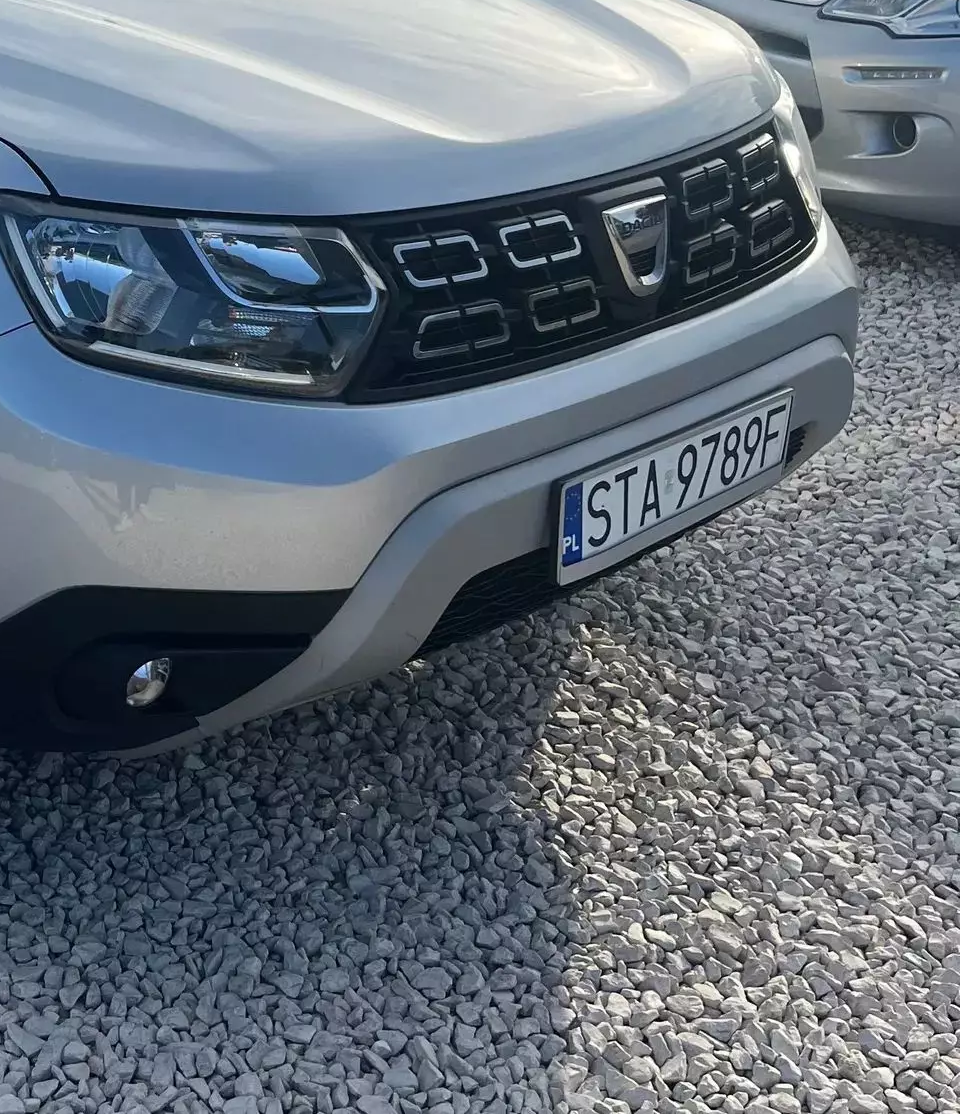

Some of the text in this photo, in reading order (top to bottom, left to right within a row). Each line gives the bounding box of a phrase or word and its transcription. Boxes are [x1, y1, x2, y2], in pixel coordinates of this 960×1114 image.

[587, 404, 788, 548] STA 9789F
[561, 534, 580, 555] PL
